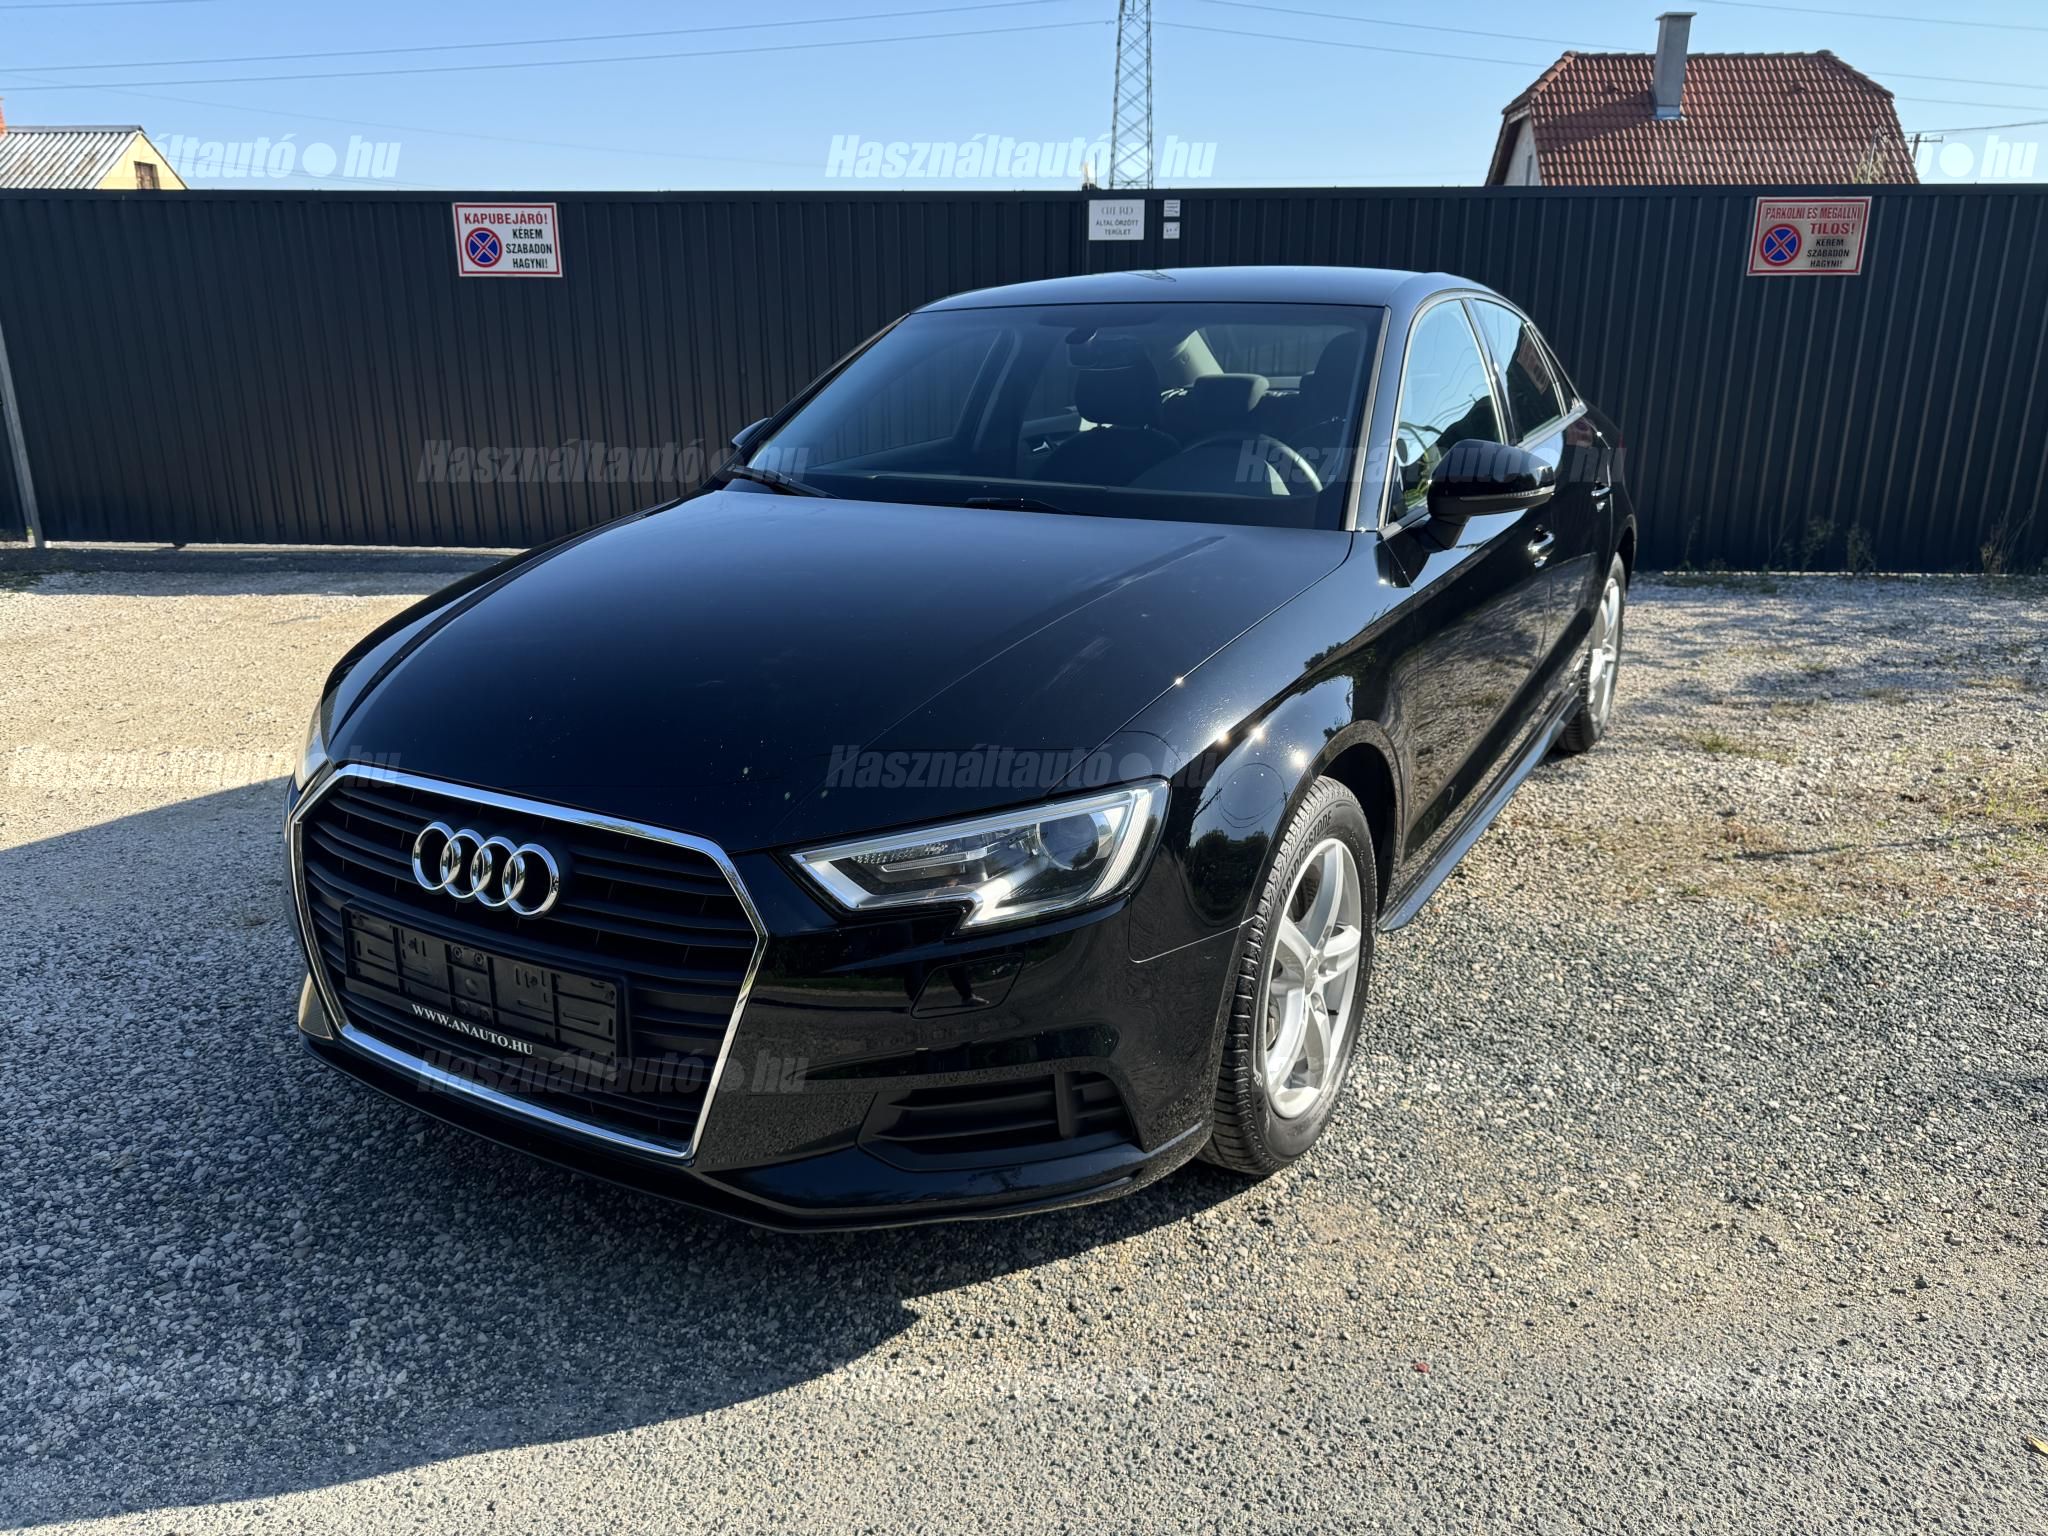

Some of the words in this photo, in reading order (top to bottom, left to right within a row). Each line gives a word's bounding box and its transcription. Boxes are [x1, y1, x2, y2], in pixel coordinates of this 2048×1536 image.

[464, 210, 548, 225] KAPUBEJÁRÓ!
[512, 226, 543, 239] KÉREM
[1810, 223, 1855, 235] TILOS!
[505, 243, 552, 255] SZABADON
[1807, 249, 1850, 258] SZABADON
[512, 258, 548, 269] HAGYNI!
[411, 1003, 533, 1055] WWW.ANAUTO.HU
